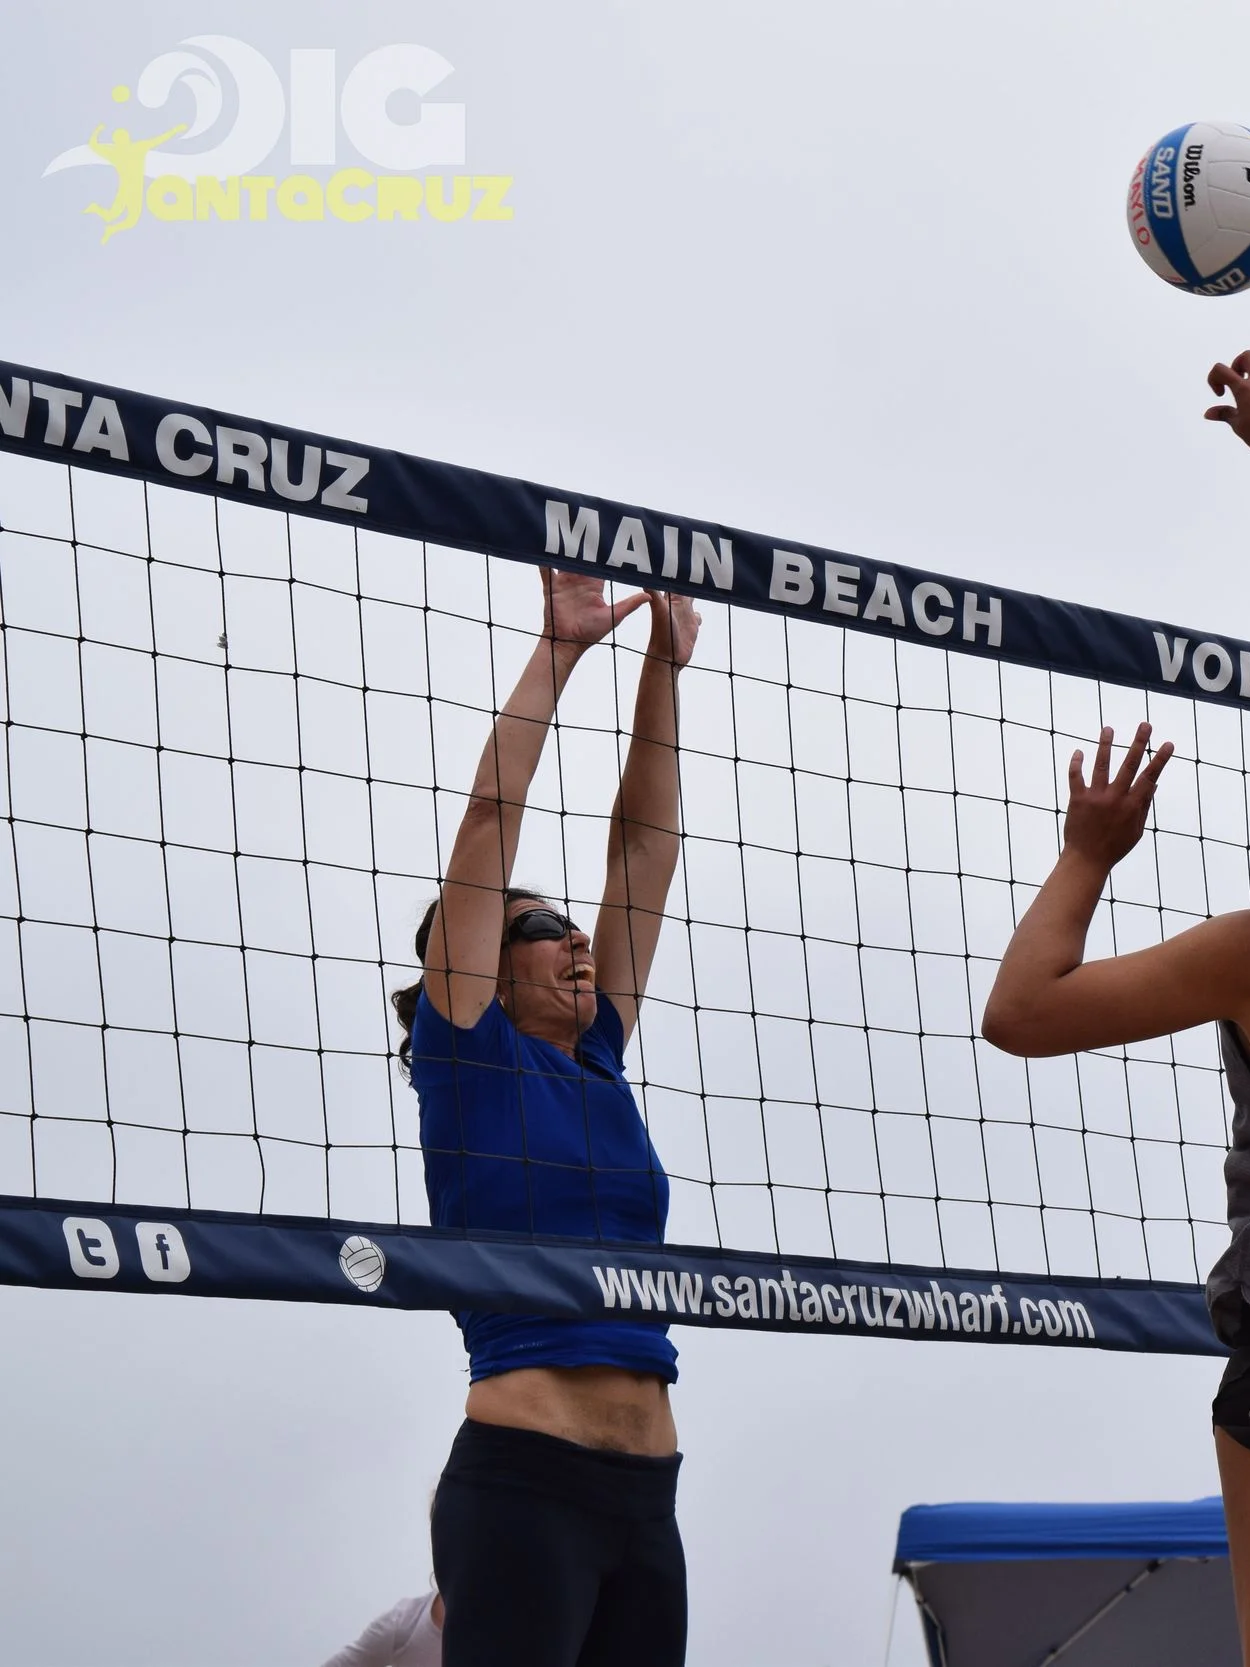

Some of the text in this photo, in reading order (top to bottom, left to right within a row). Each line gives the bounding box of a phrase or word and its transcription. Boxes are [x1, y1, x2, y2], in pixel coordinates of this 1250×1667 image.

[1152, 147, 1175, 219] SAND
[1183, 144, 1204, 211] Wilson
[156, 413, 370, 514] CRUZ
[545, 500, 734, 591] MAIN
[769, 549, 1002, 647] BEACH
[592, 1266, 1096, 1339] www.santacruzwharf.com
